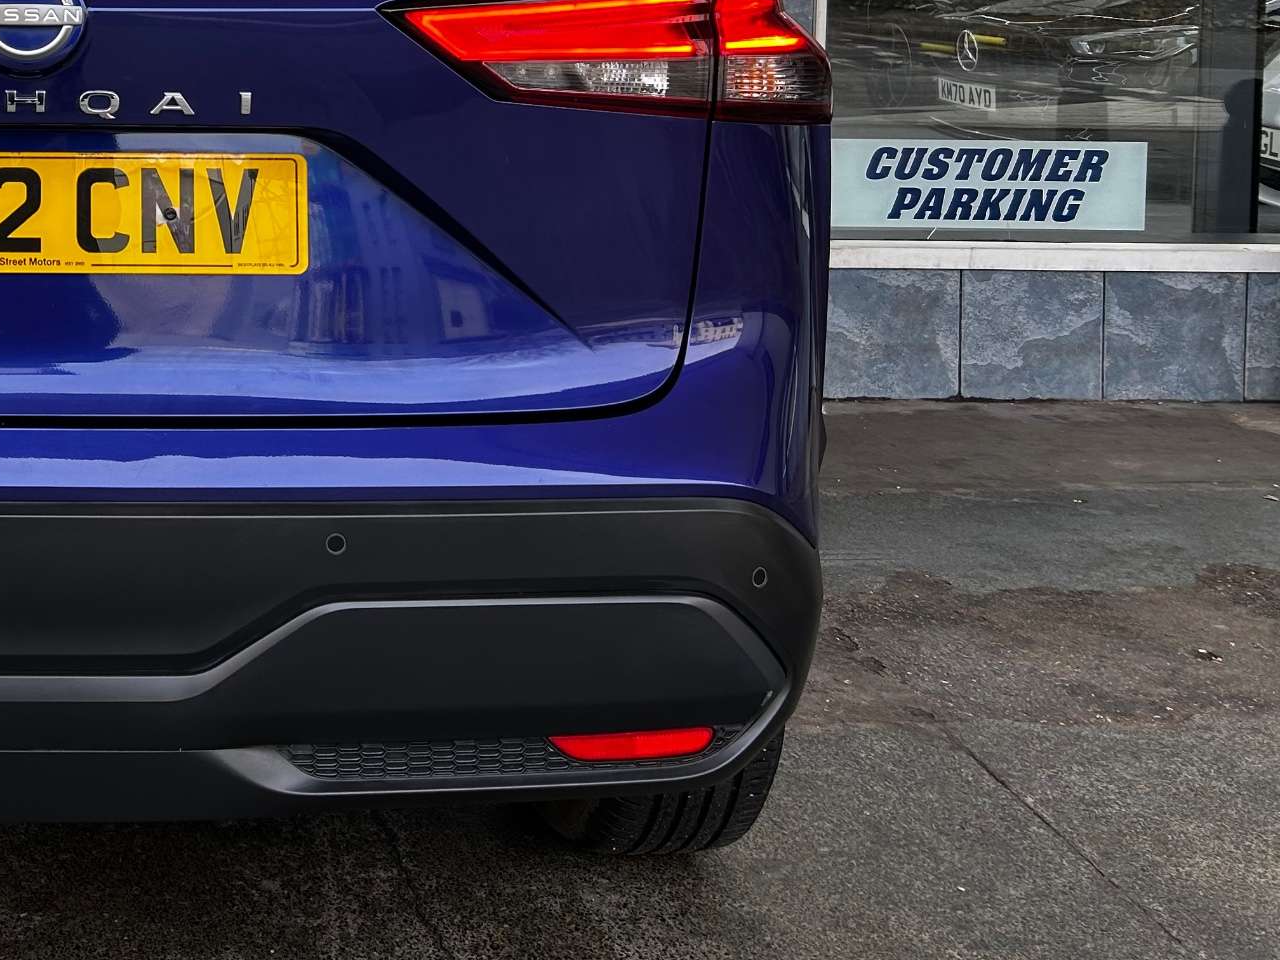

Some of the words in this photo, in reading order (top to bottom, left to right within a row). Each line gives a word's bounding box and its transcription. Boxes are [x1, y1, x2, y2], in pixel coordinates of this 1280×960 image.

[865, 146, 1110, 183] CUSTOMER
[76, 166, 260, 254] CNV
[886, 187, 1086, 222] PARKING
[0, 256, 27, 266] Street
[29, 257, 61, 266] Motors
